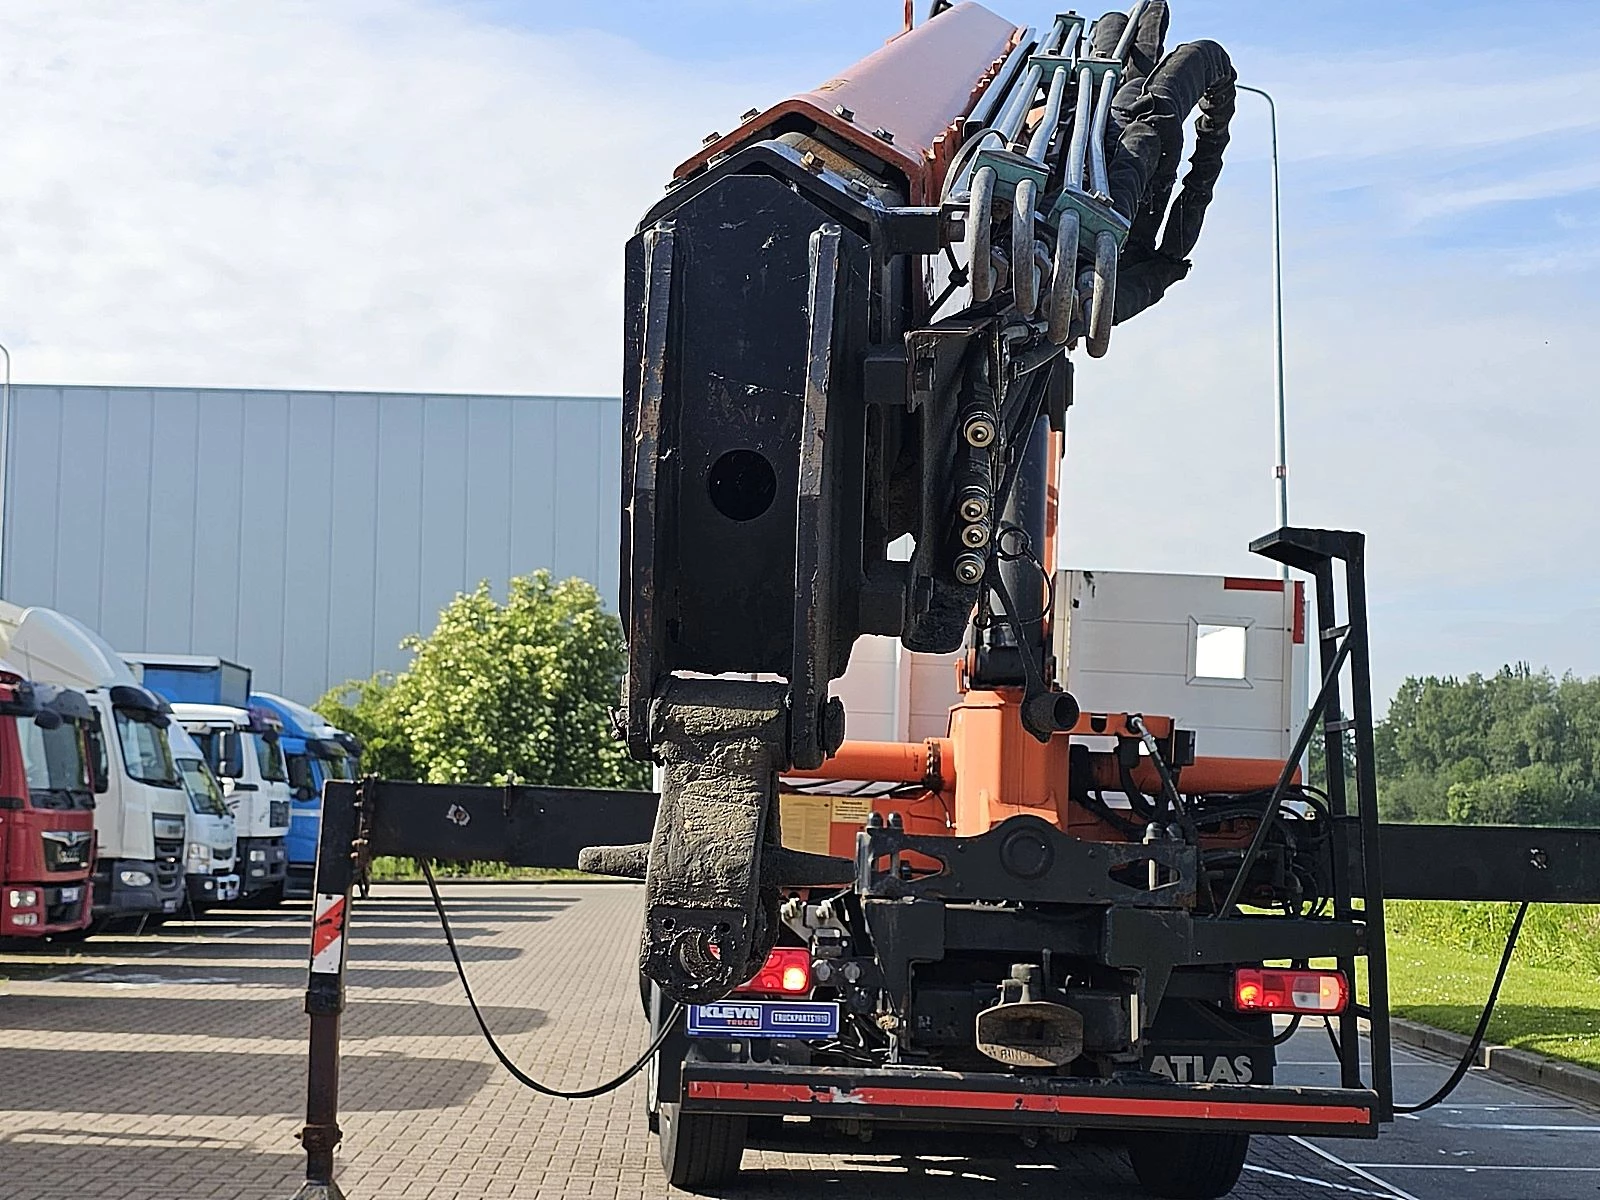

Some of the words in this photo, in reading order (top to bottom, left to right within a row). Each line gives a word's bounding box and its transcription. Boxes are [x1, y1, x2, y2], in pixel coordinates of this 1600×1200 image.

[699, 1005, 760, 1019] KLEYN
[726, 1019, 759, 1027] TRUCKS
[1149, 1055, 1253, 1083] ATLAS
